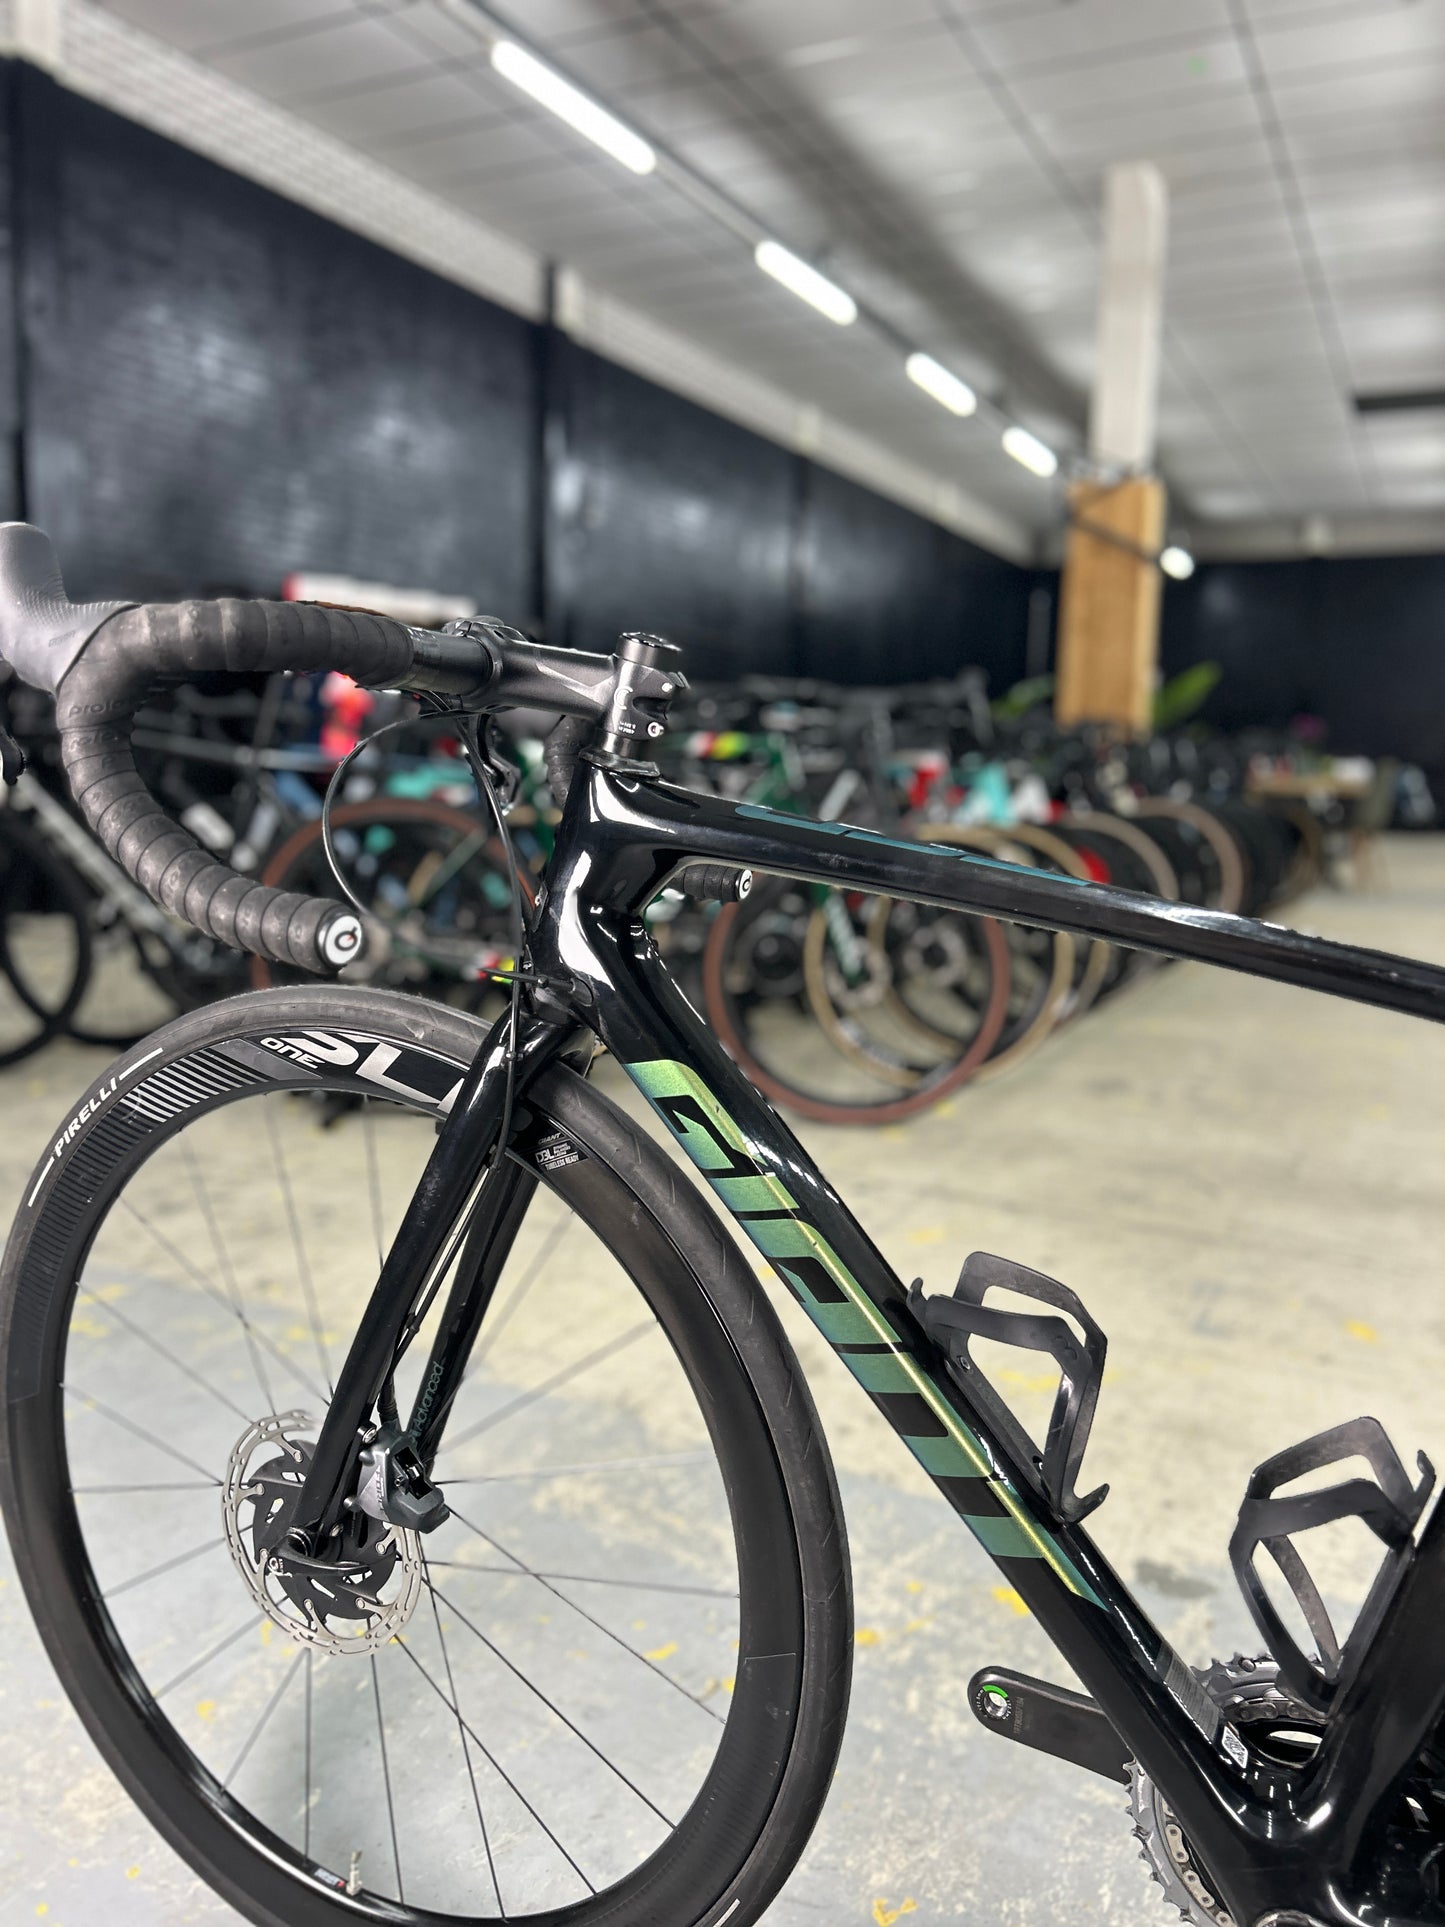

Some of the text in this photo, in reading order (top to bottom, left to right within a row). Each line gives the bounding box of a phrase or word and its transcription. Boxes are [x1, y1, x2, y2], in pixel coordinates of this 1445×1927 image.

[260, 1037, 326, 1069] ONE
[54, 1077, 118, 1158] PIRELLI
[622, 1058, 1109, 1613] GIANT
[414, 1361, 445, 1429] Advanced
